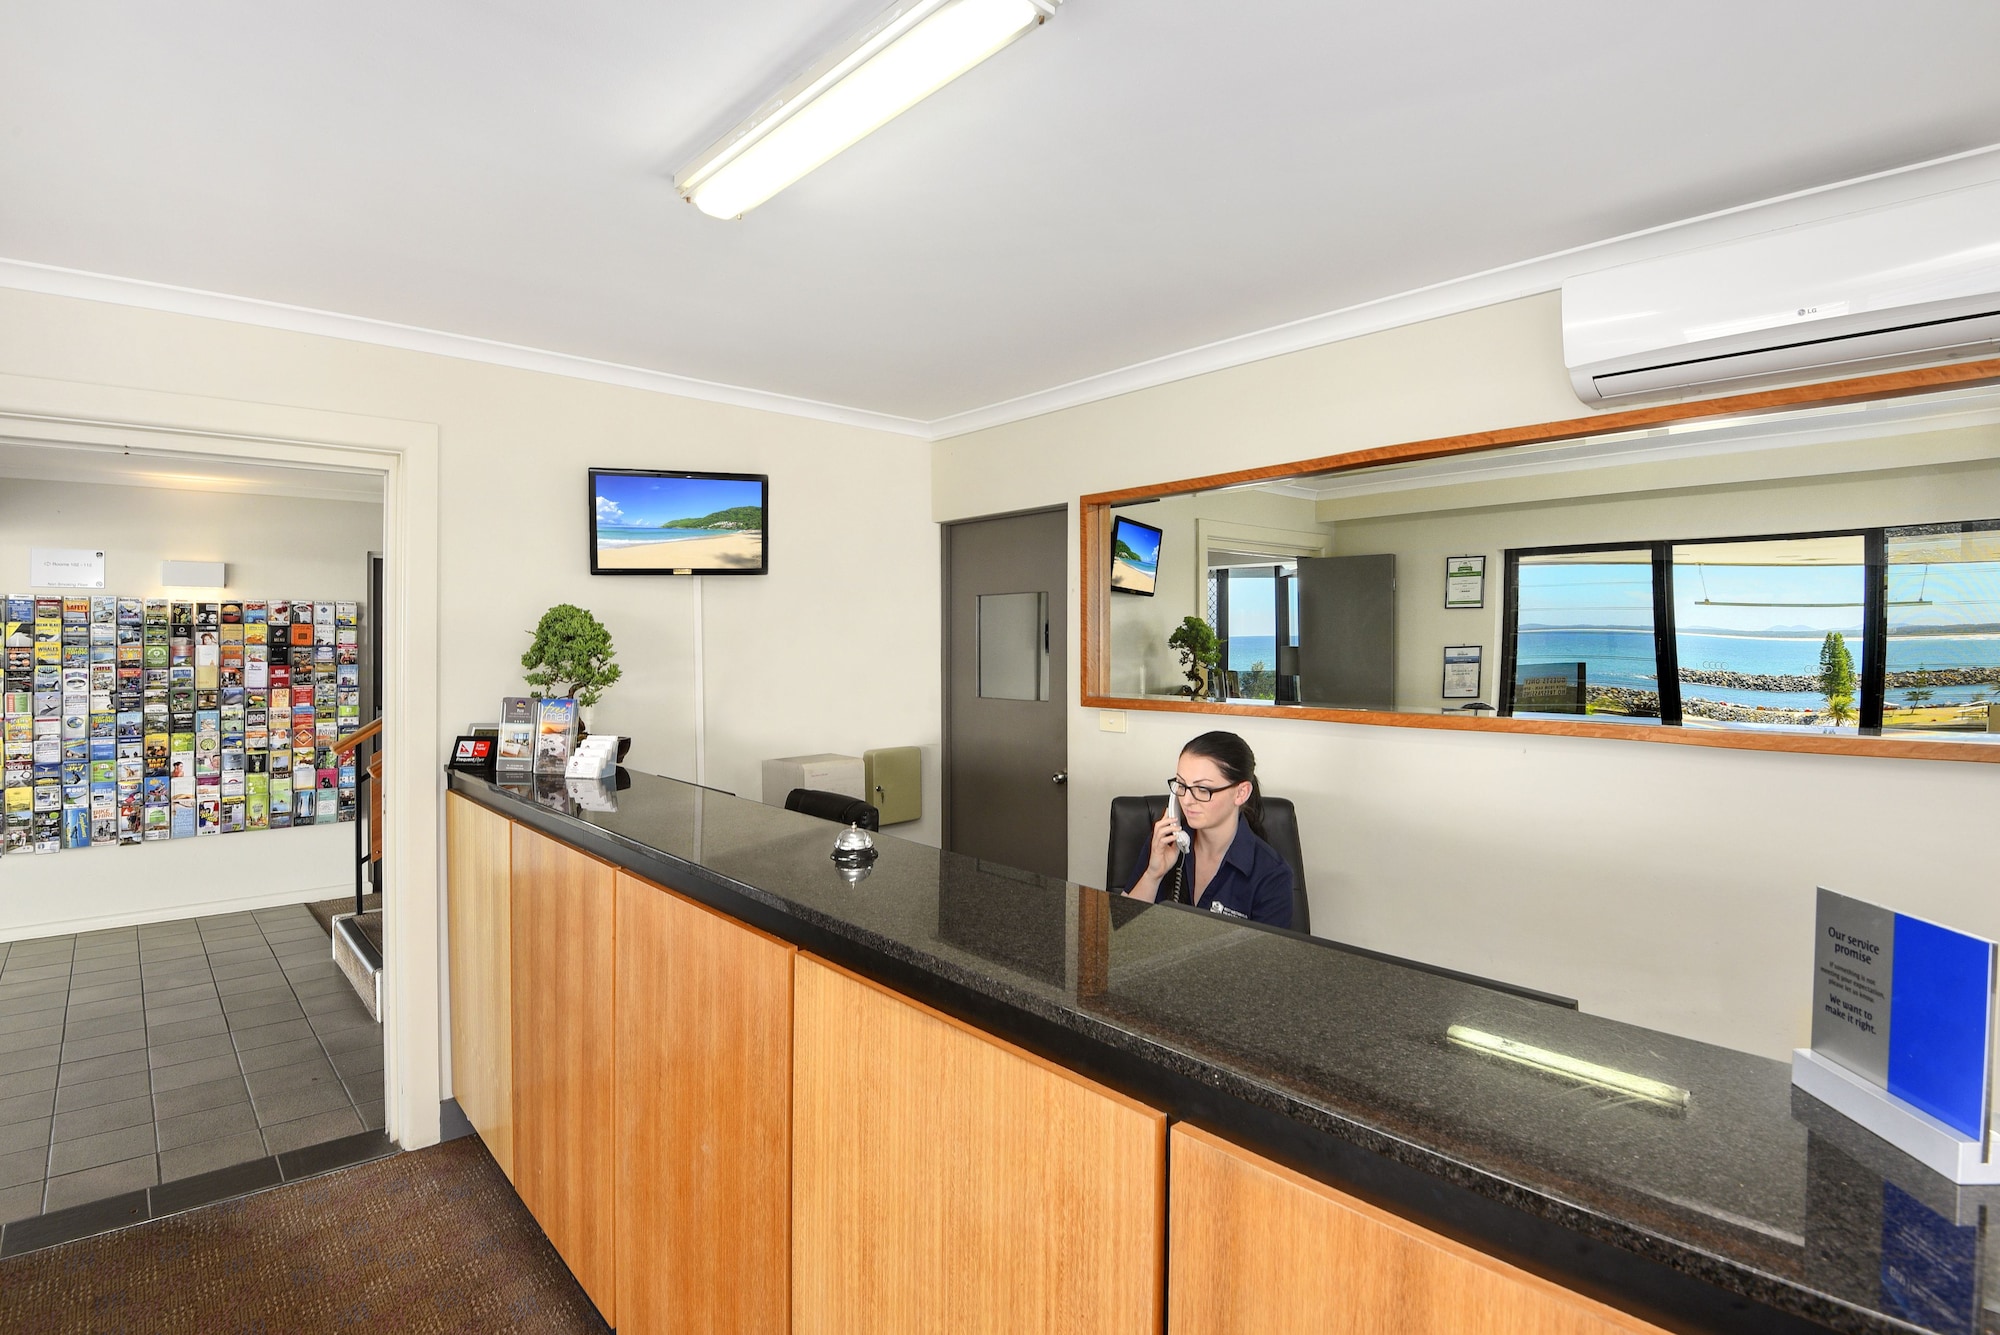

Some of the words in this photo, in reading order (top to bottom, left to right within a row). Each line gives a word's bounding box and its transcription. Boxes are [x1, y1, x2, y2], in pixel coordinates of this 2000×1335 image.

[543, 701, 568, 716] free
[546, 712, 570, 722] map
[1828, 926, 1846, 941] Our
[1848, 935, 1880, 955] service
[1834, 943, 1872, 965] promise
[1834, 964, 1860, 980] something
[1829, 993, 1841, 1006] We
[1843, 1001, 1862, 1017] want
[1864, 1010, 1873, 1021] to
[1825, 1004, 1846, 1020] make
[1847, 1014, 1854, 1024] it
[1855, 1018, 1877, 1035] right.
